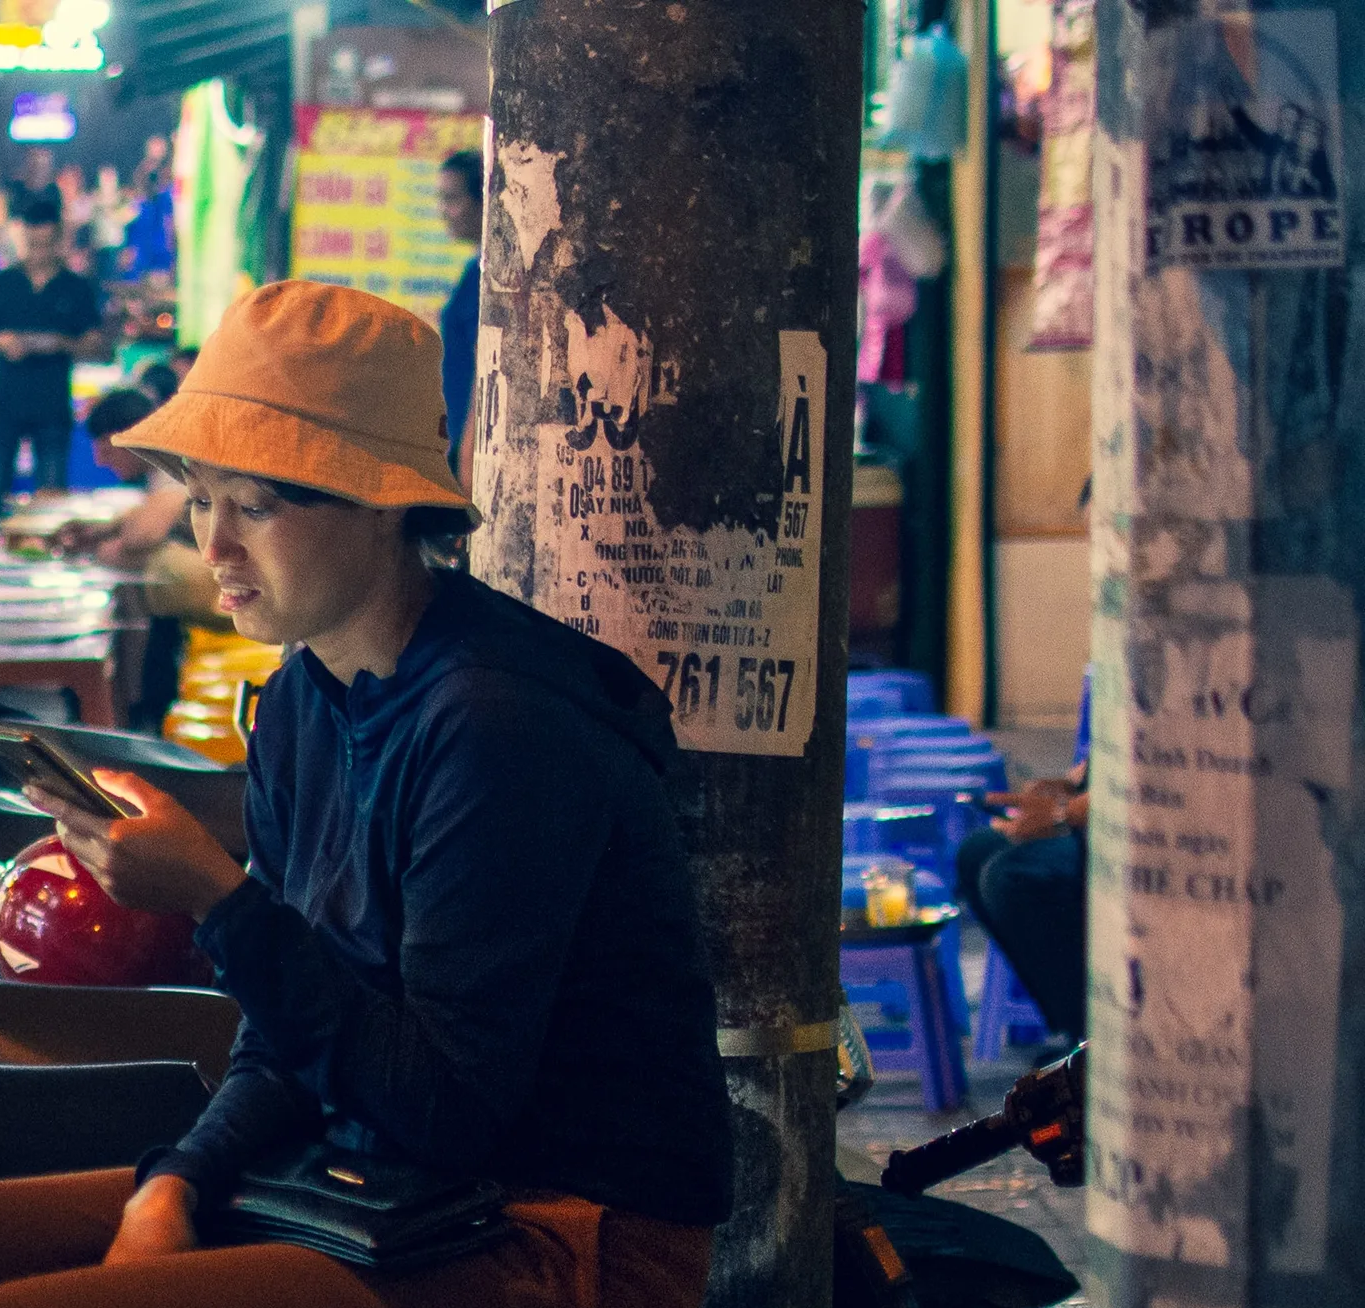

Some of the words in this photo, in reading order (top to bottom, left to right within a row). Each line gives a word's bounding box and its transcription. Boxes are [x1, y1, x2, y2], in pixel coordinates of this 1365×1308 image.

[583, 455, 605, 492] 04
[612, 455, 634, 492] 89
[784, 502, 809, 539] 567
[657, 651, 721, 726] 761
[734, 657, 796, 733] 567
